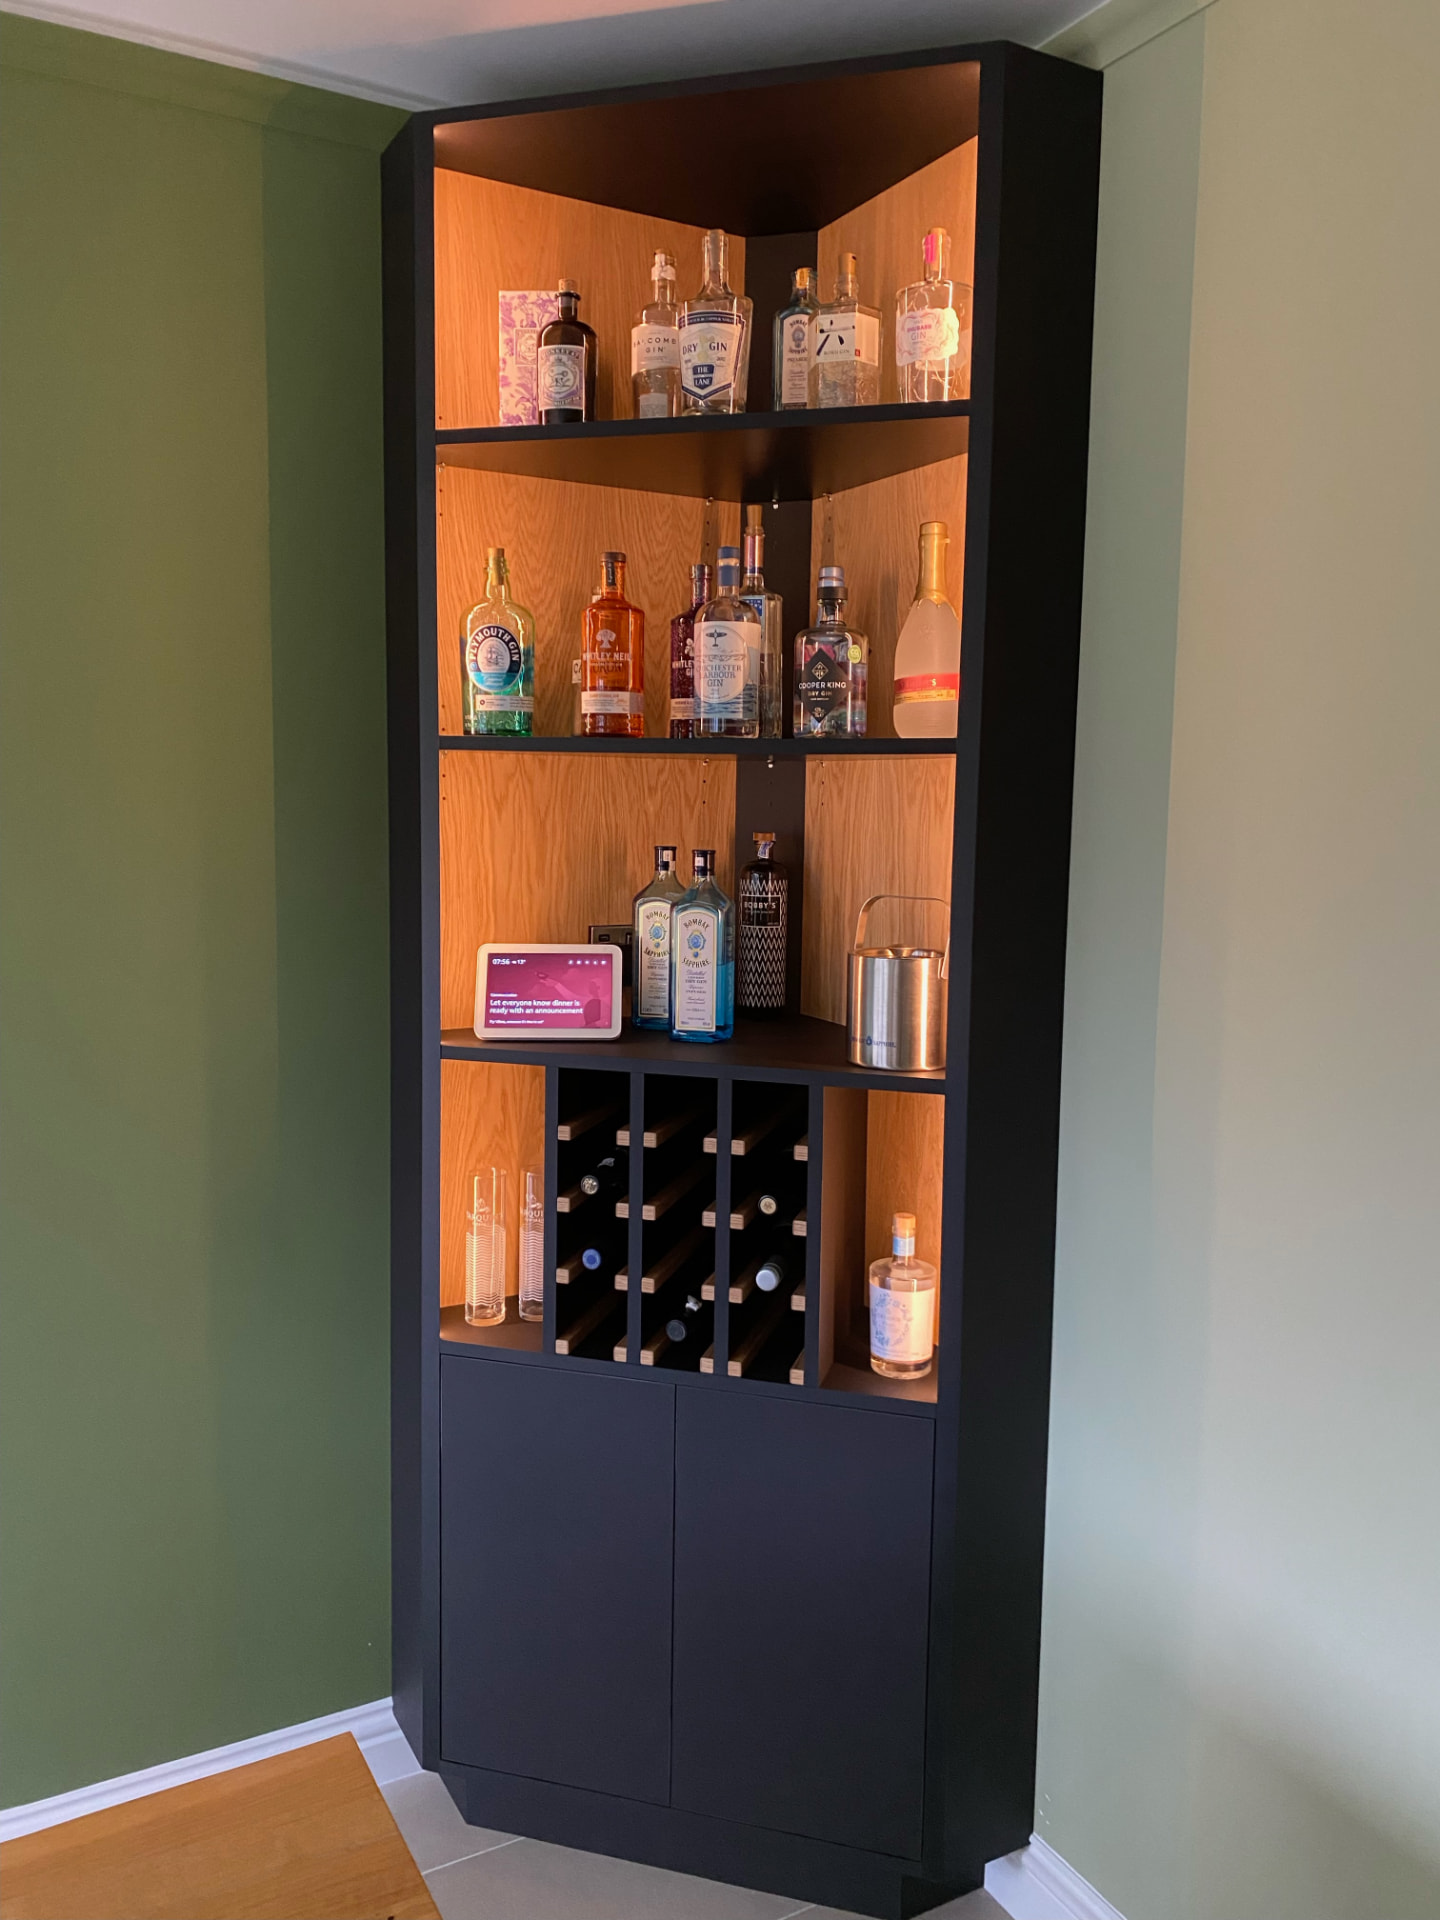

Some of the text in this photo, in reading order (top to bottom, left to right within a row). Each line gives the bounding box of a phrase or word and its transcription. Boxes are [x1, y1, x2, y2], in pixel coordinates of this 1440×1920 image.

[911, 331, 927, 341] GIN
[645, 345, 665, 353] GIN
[682, 341, 727, 355] DRY GIN
[469, 627, 520, 661] PLYMOUTH GIN
[706, 678, 724, 687] GIN
[799, 681, 847, 690] COOPER KING
[683, 918, 711, 932] BOMBAY
[491, 958, 510, 966] 07:56
[682, 956, 712, 969] SAPPHIRE
